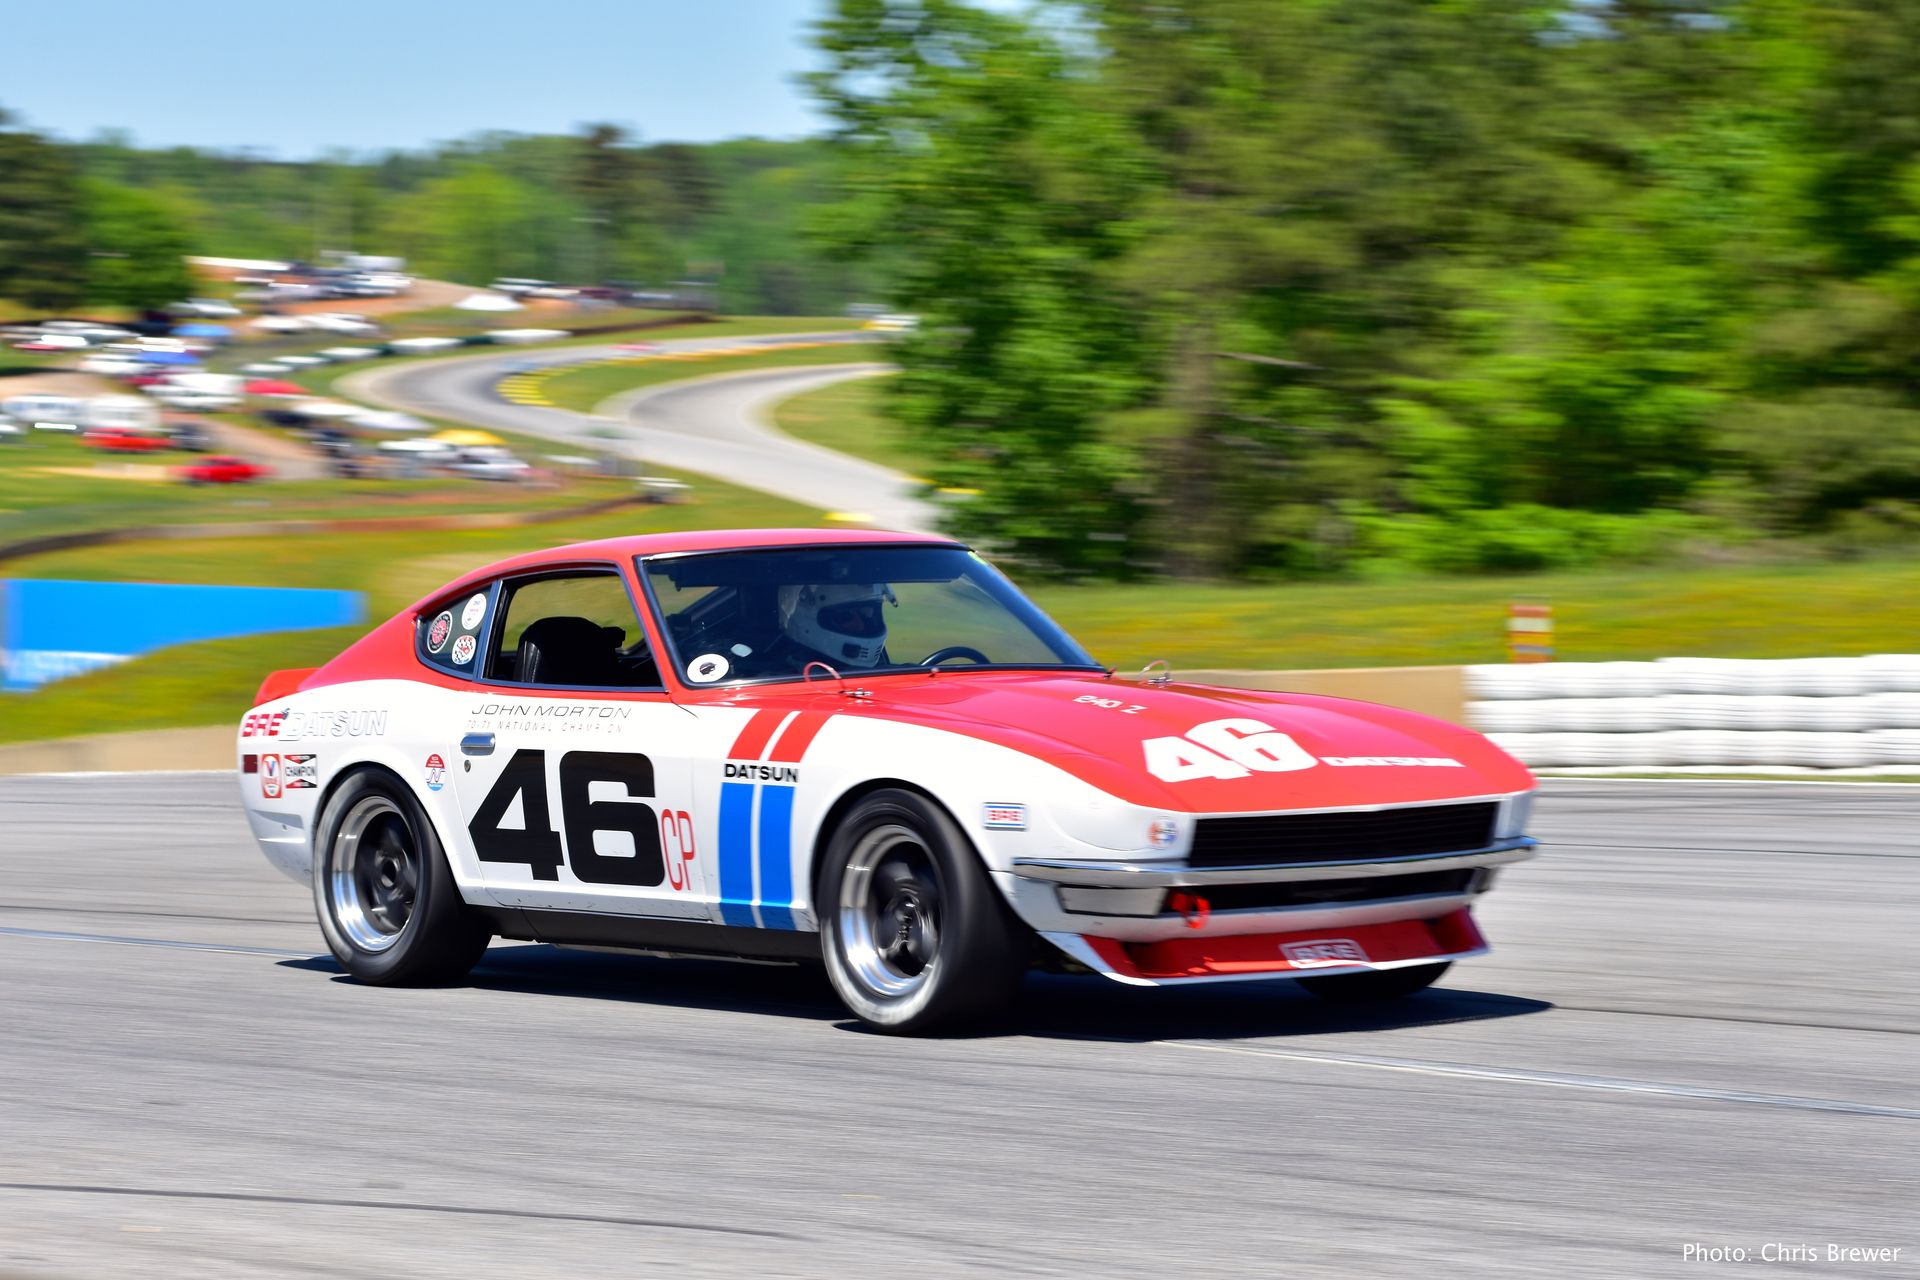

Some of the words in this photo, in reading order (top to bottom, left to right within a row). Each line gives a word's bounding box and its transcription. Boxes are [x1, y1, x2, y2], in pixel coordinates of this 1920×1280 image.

[471, 704, 531, 716] JOHN
[534, 705, 631, 719] MORTON
[1120, 704, 1148, 714] Z
[278, 709, 388, 742] DATSUN
[497, 720, 552, 732] NATIONAL
[562, 723, 623, 734] CHAMPON
[1141, 717, 1319, 783] 46
[723, 762, 799, 783] DATSUN
[467, 748, 666, 887] 46
[660, 808, 696, 891] CP
